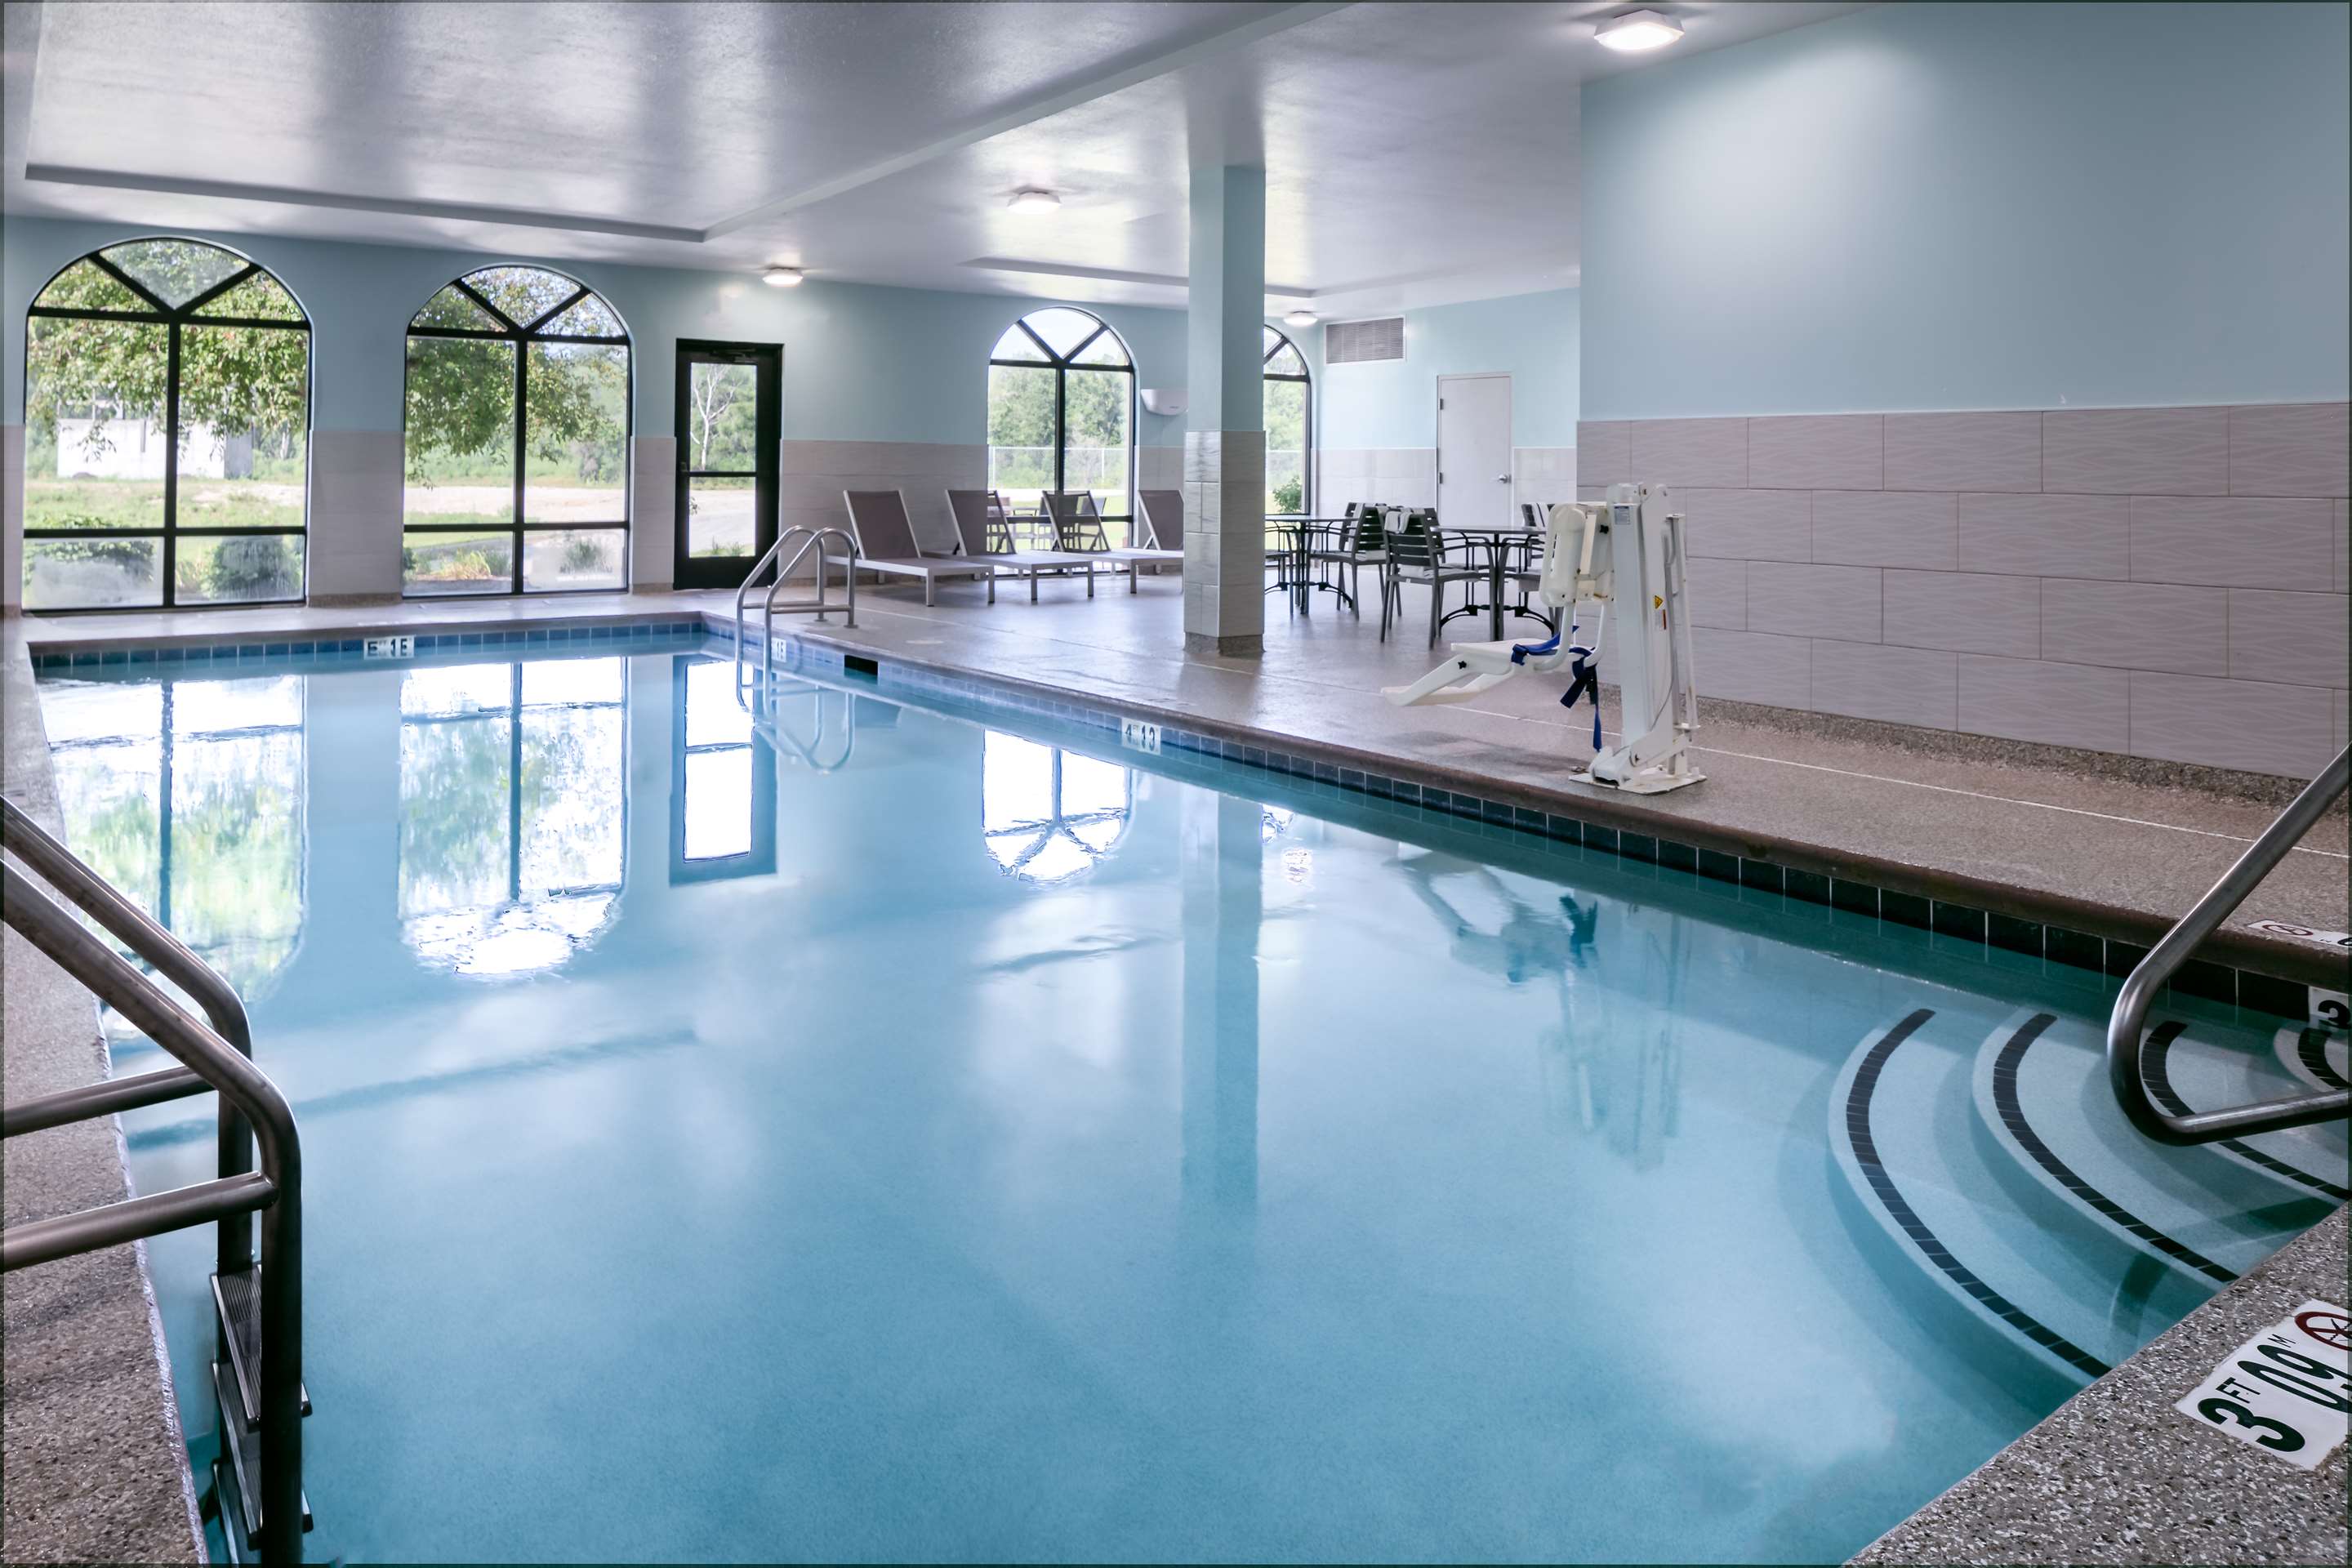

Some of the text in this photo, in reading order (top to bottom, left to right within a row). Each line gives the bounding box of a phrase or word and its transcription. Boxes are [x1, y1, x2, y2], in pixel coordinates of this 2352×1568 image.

[2267, 1334, 2296, 1348] M
[2216, 1377, 2261, 1404] FT
[2198, 1398, 2305, 1452] 3
